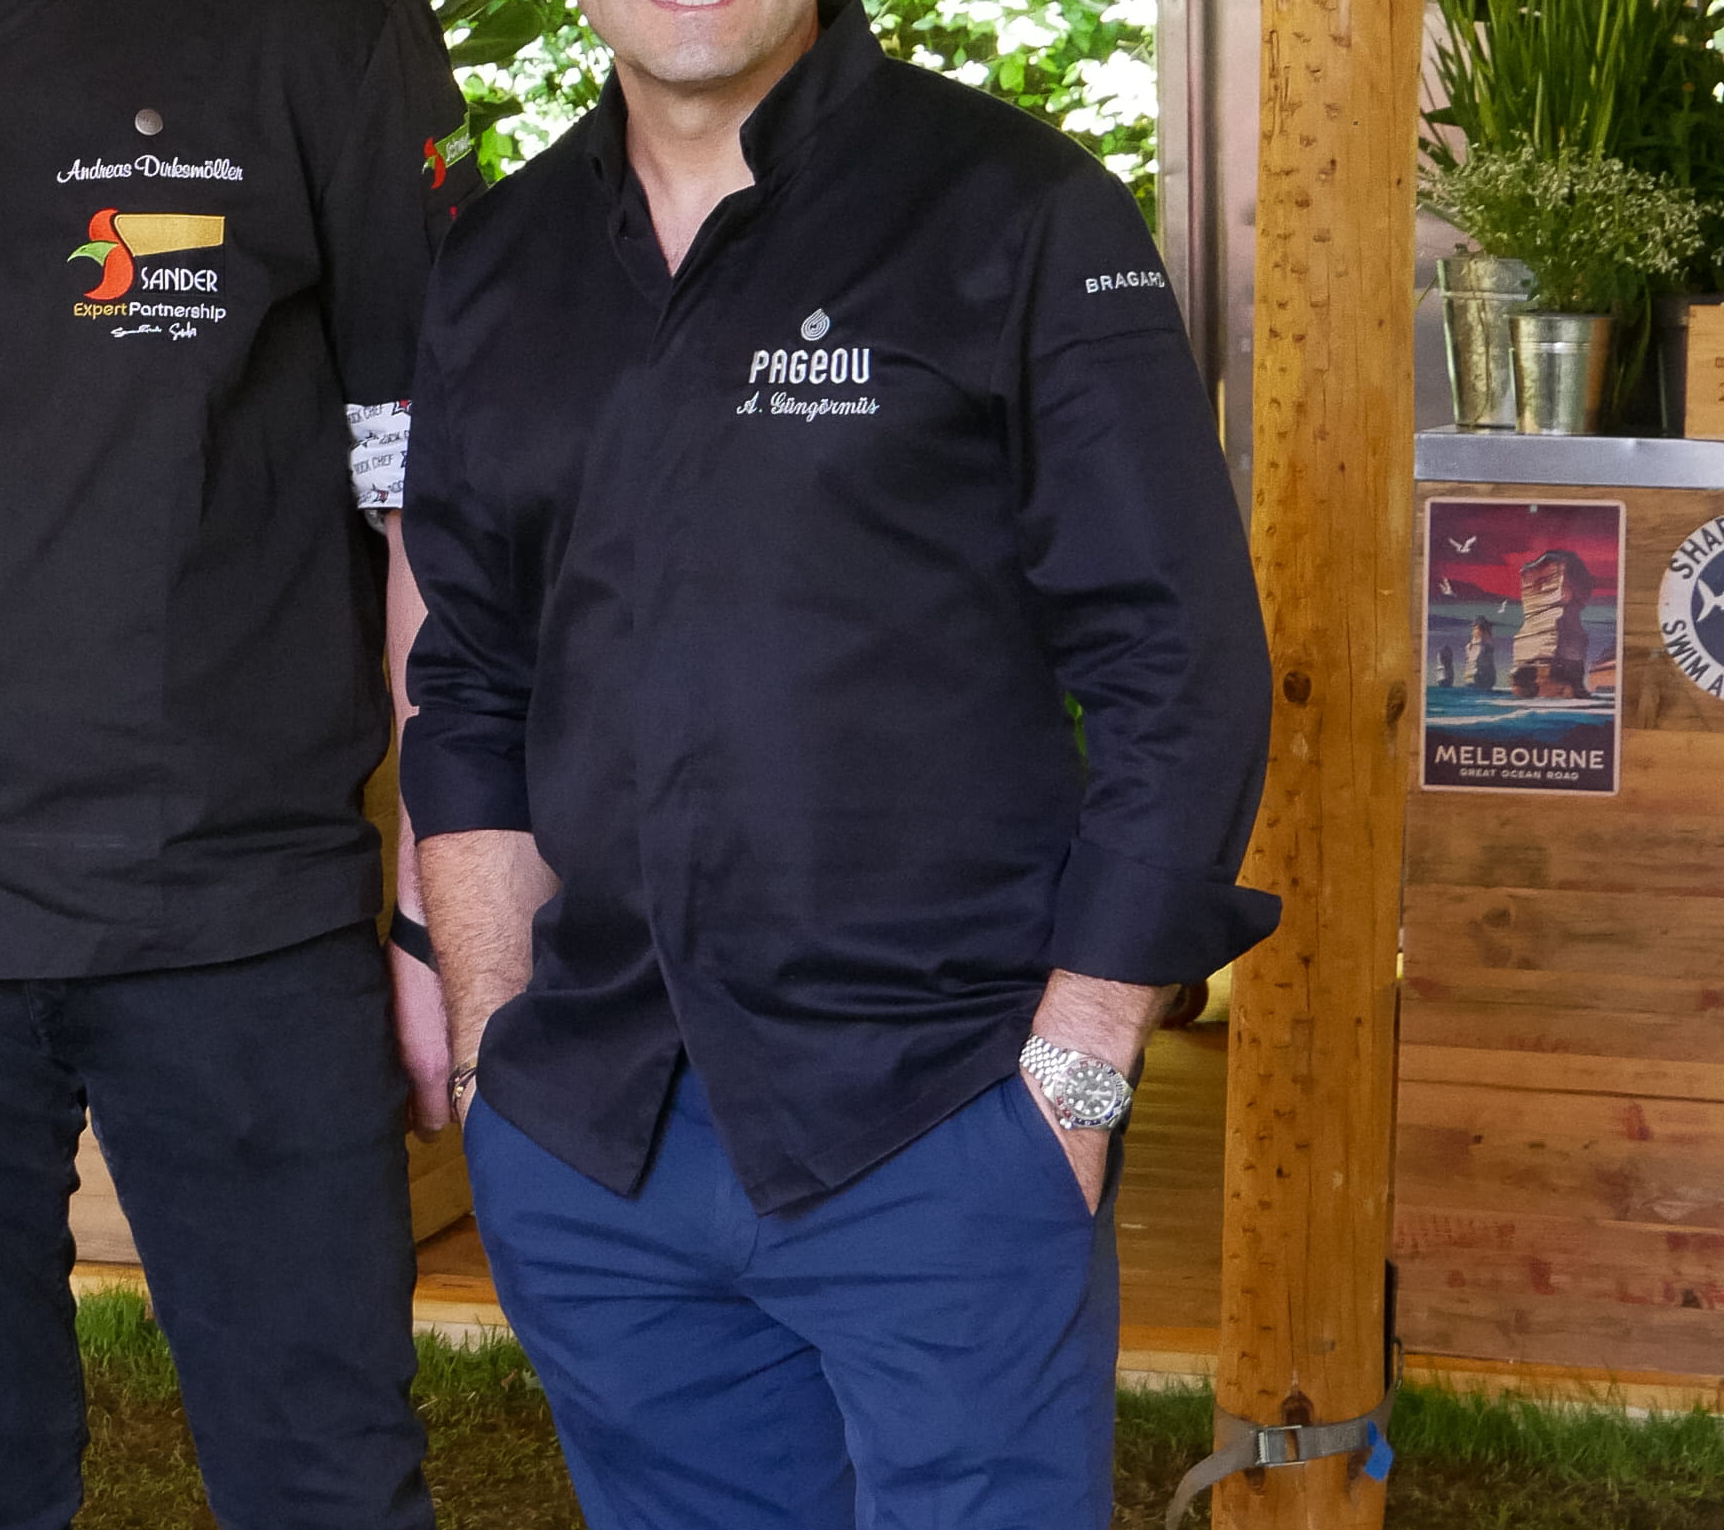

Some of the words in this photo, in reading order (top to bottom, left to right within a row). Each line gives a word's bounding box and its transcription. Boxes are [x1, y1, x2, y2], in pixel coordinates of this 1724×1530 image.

[57, 157, 132, 184] Andreas
[140, 266, 219, 293] SANDER
[1661, 619, 1710, 683] SWIM
[1434, 744, 1605, 770] MELBOURNE
